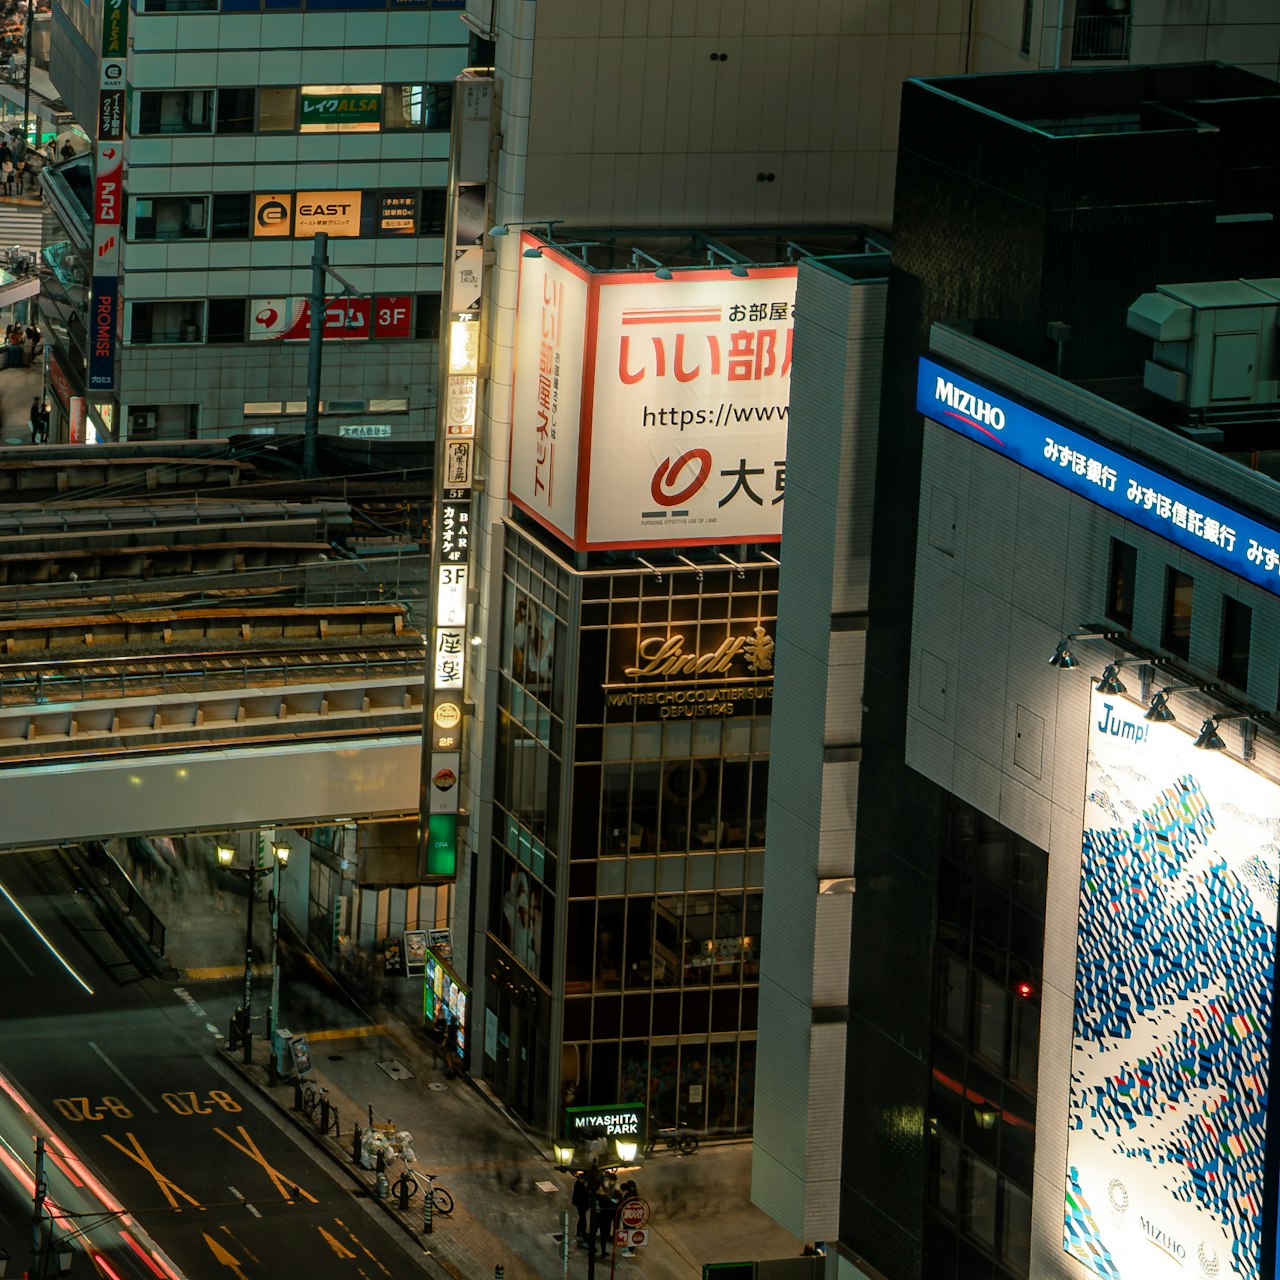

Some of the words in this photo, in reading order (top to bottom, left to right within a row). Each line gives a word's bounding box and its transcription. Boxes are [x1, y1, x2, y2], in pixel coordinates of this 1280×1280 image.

[108, 9, 122, 51] ALSA
[103, 98, 112, 132] クリニック
[111, 93, 121, 136] イースト駅前
[303, 100, 339, 113] レイク
[338, 99, 379, 111] ALSA
[100, 182, 116, 219] アコム
[299, 204, 351, 216] EAST
[96, 295, 112, 358] PROMISE
[379, 309, 406, 325] 3F
[458, 313, 473, 322] 7F
[619, 329, 793, 385] いい部
[91, 376, 112, 385] プロミス
[450, 378, 474, 387] DARTS
[458, 387, 474, 396] BAR
[935, 376, 1006, 432] MIZUHO
[449, 489, 465, 499] 5F
[1043, 437, 1118, 492] みずほ銀行
[1126, 479, 1236, 552] みずほ信託銀行
[1246, 540, 1280, 573] みず
[443, 507, 456, 554] カラオケ
[459, 512, 469, 549] BAR
[448, 552, 461, 561] 4F
[442, 568, 466, 585] 3F
[624, 633, 745, 677] Lindt
[608, 689, 654, 707] MAÎTRE
[655, 687, 747, 706] CHOCOLATIER
[660, 705, 704, 718] DEPUIS
[1097, 702, 1150, 746] Jump!
[438, 737, 454, 748] 2F
[161, 1091, 243, 1116] 8-20
[575, 1114, 639, 1128] MIYASHITA
[606, 1123, 639, 1135] PARK
[1140, 1215, 1187, 1259] MIZUHO
